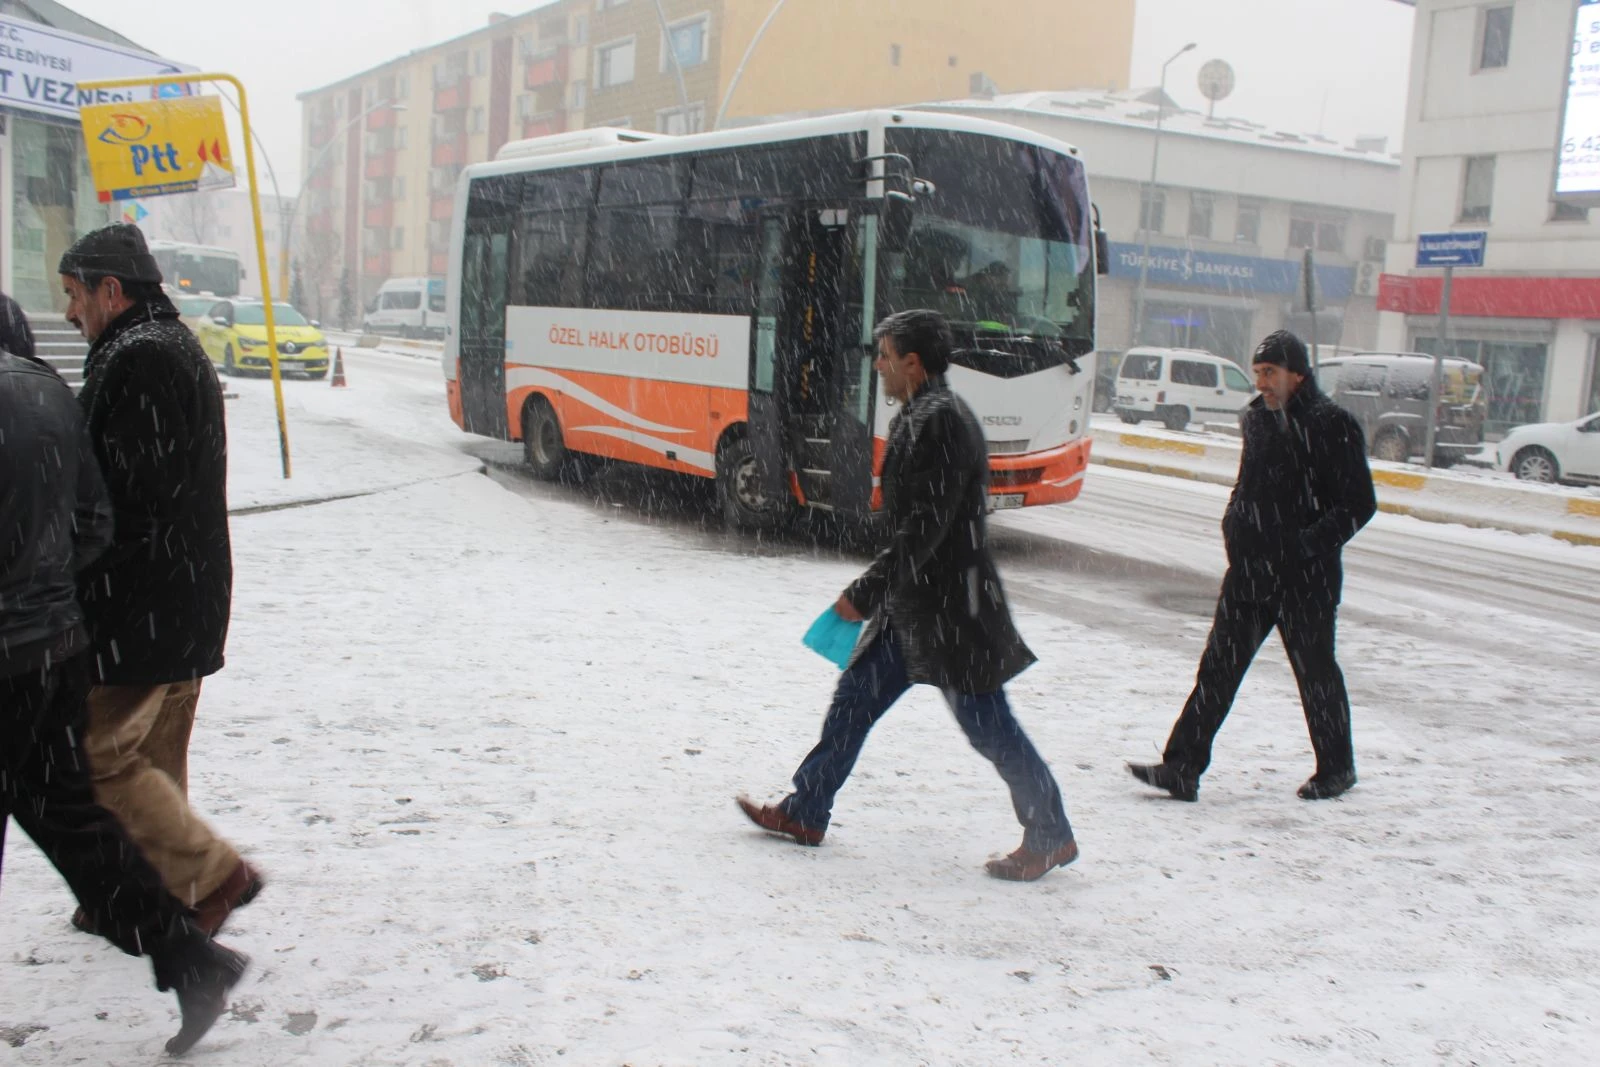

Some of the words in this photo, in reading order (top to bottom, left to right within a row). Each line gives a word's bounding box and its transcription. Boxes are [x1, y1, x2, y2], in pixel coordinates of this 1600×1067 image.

[1195, 261, 1254, 278] BANKASI
[549, 324, 584, 347] ÖZEL
[588, 331, 629, 350] HALK
[634, 331, 719, 358] OTOBÜSÜ
